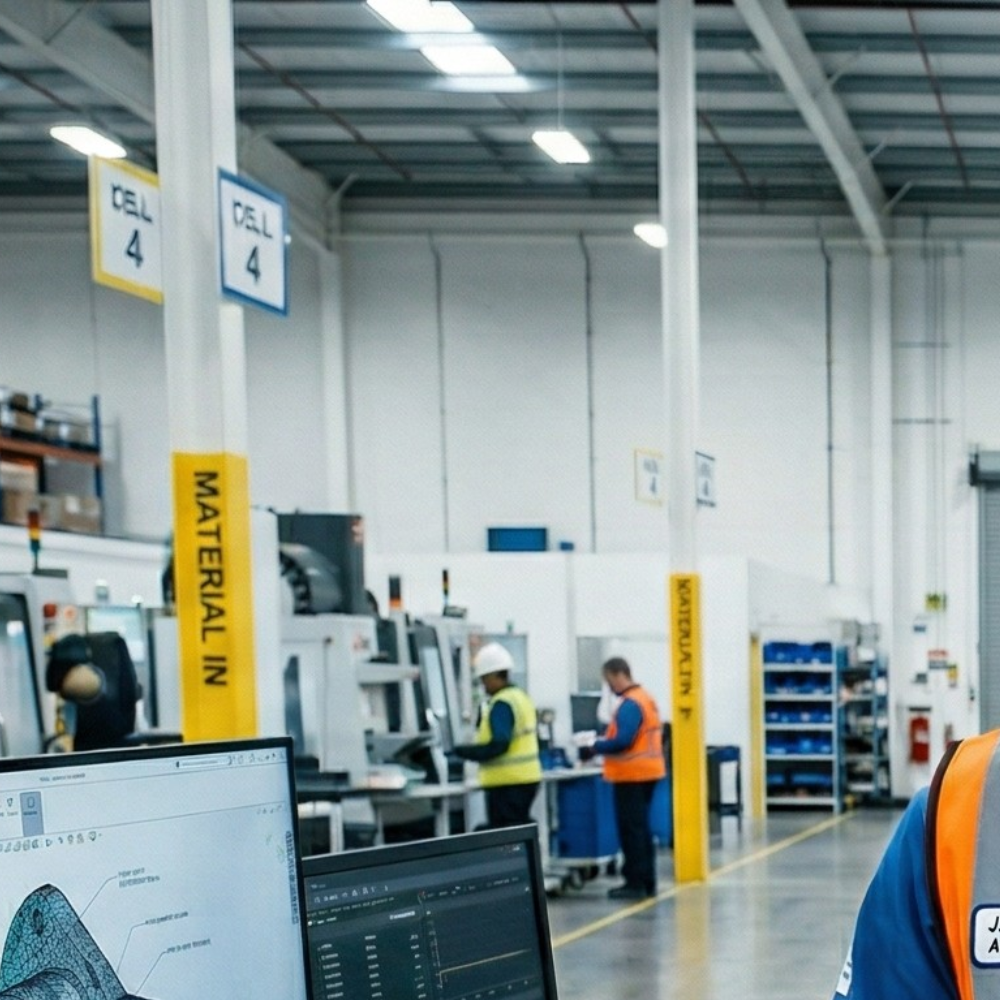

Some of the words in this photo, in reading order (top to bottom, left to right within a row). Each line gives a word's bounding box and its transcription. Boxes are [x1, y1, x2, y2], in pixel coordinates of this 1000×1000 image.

[126, 229, 143, 269] 4
[246, 245, 261, 284] 4
[194, 471, 226, 643] MATERIAL
[203, 654, 228, 687] IN
